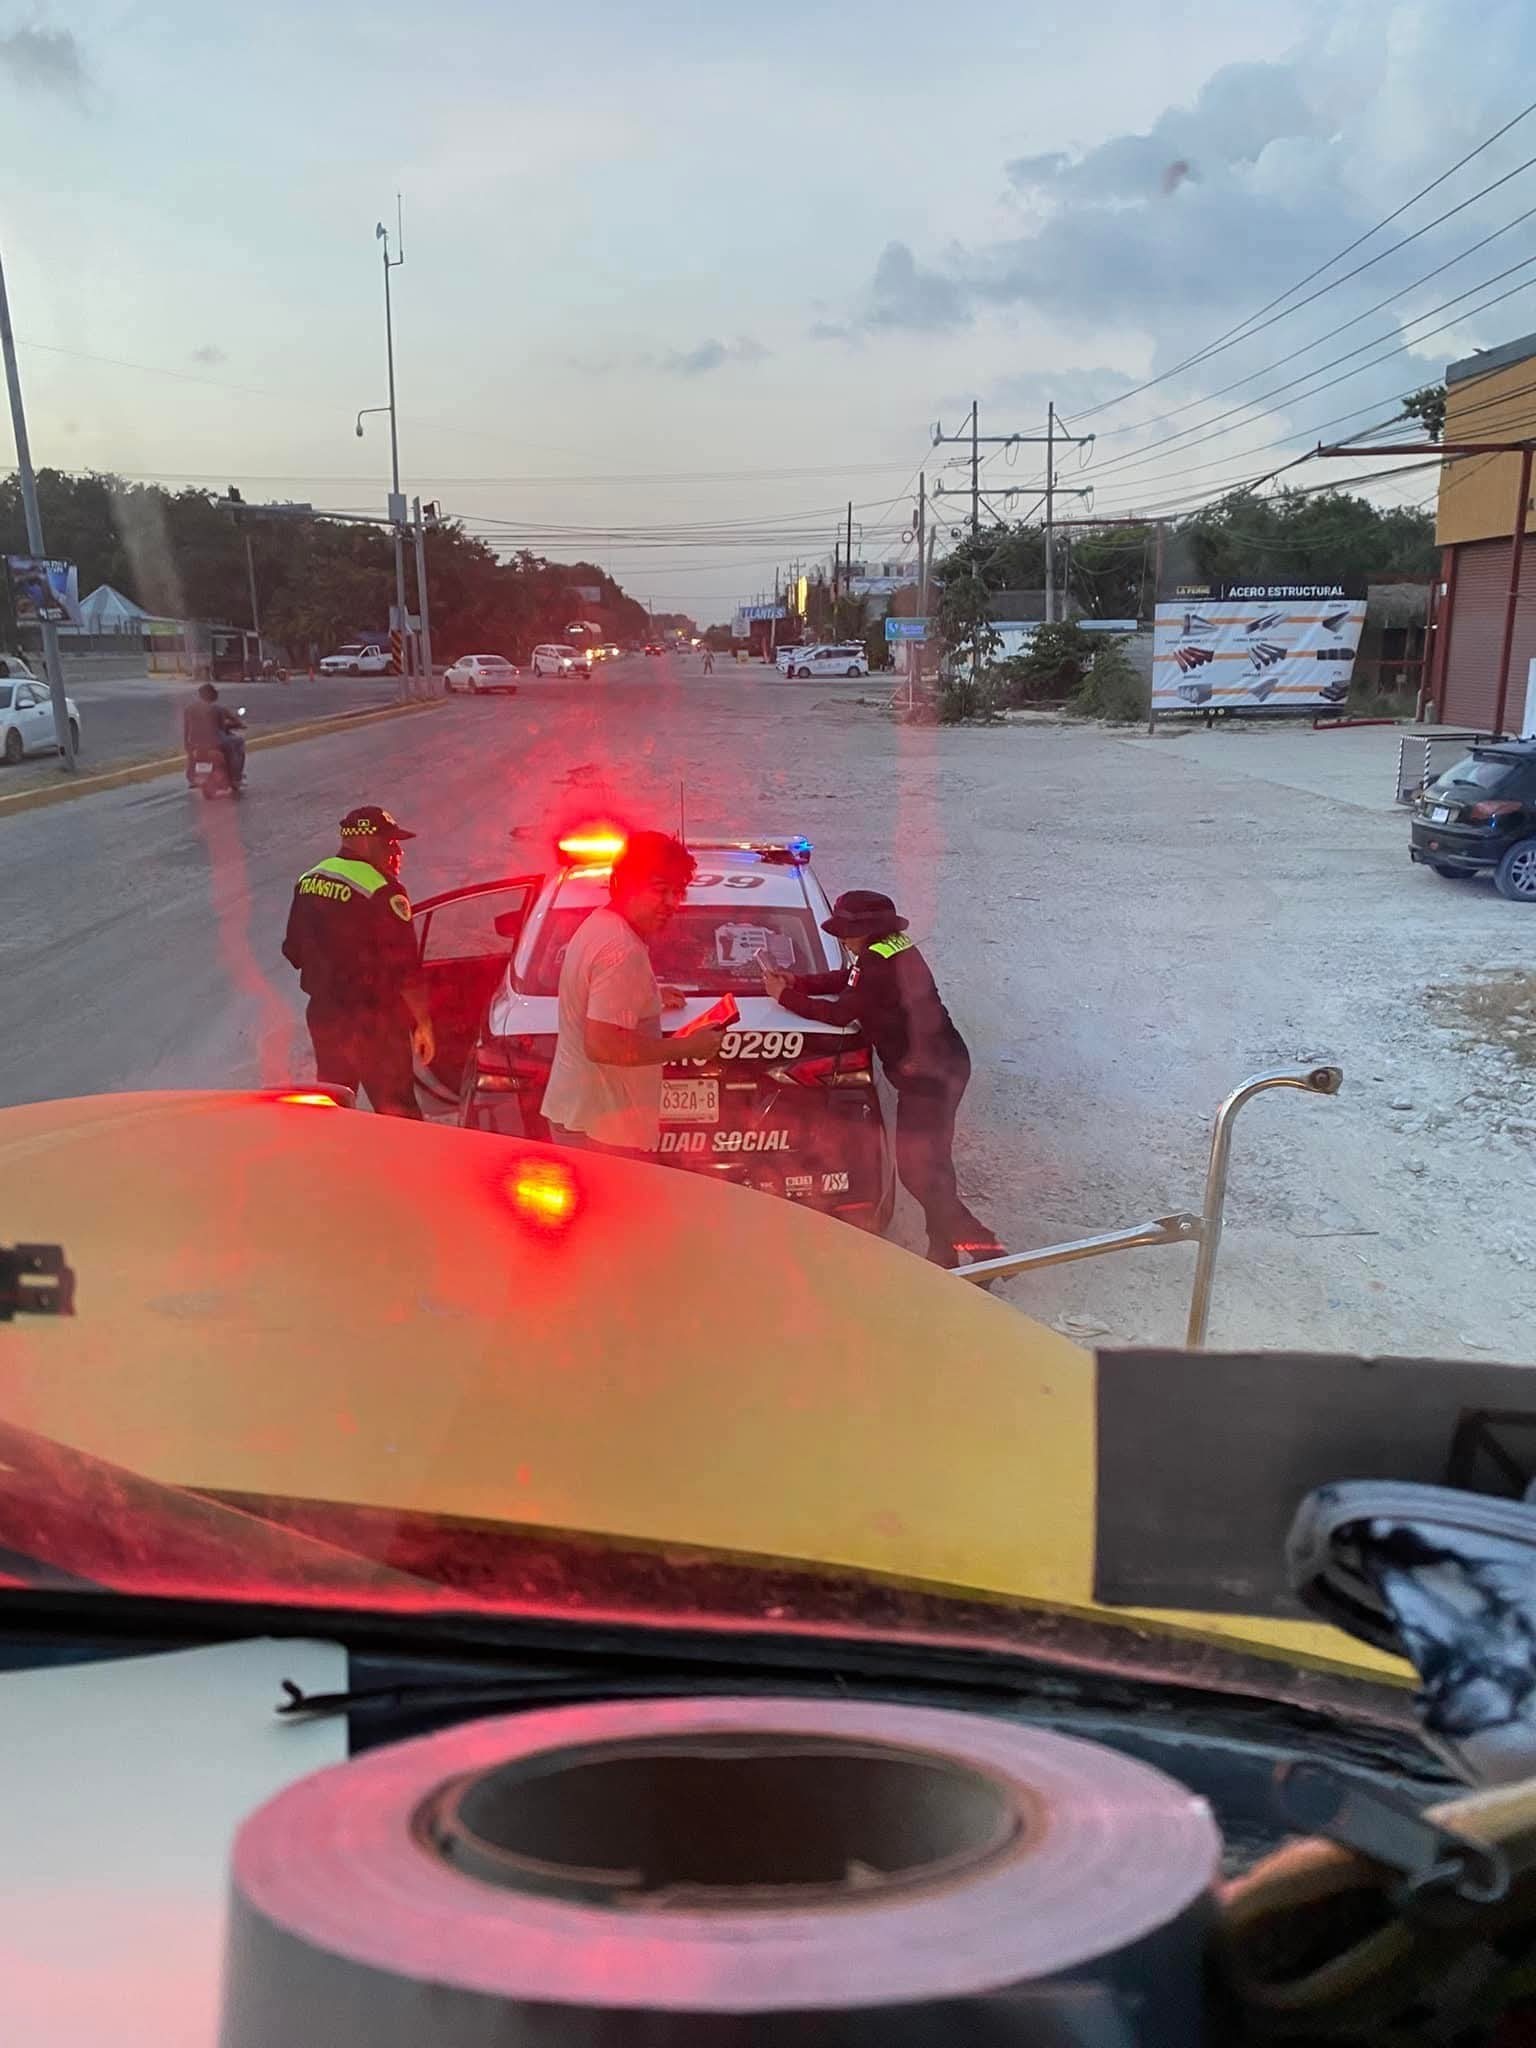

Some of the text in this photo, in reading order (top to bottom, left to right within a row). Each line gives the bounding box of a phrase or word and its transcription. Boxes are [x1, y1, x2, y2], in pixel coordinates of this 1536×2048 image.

[1229, 585, 1345, 597] ACERO ESTRUCTURAL
[719, 1032, 804, 1059] 9299
[711, 1130, 790, 1152] SOCIAL
